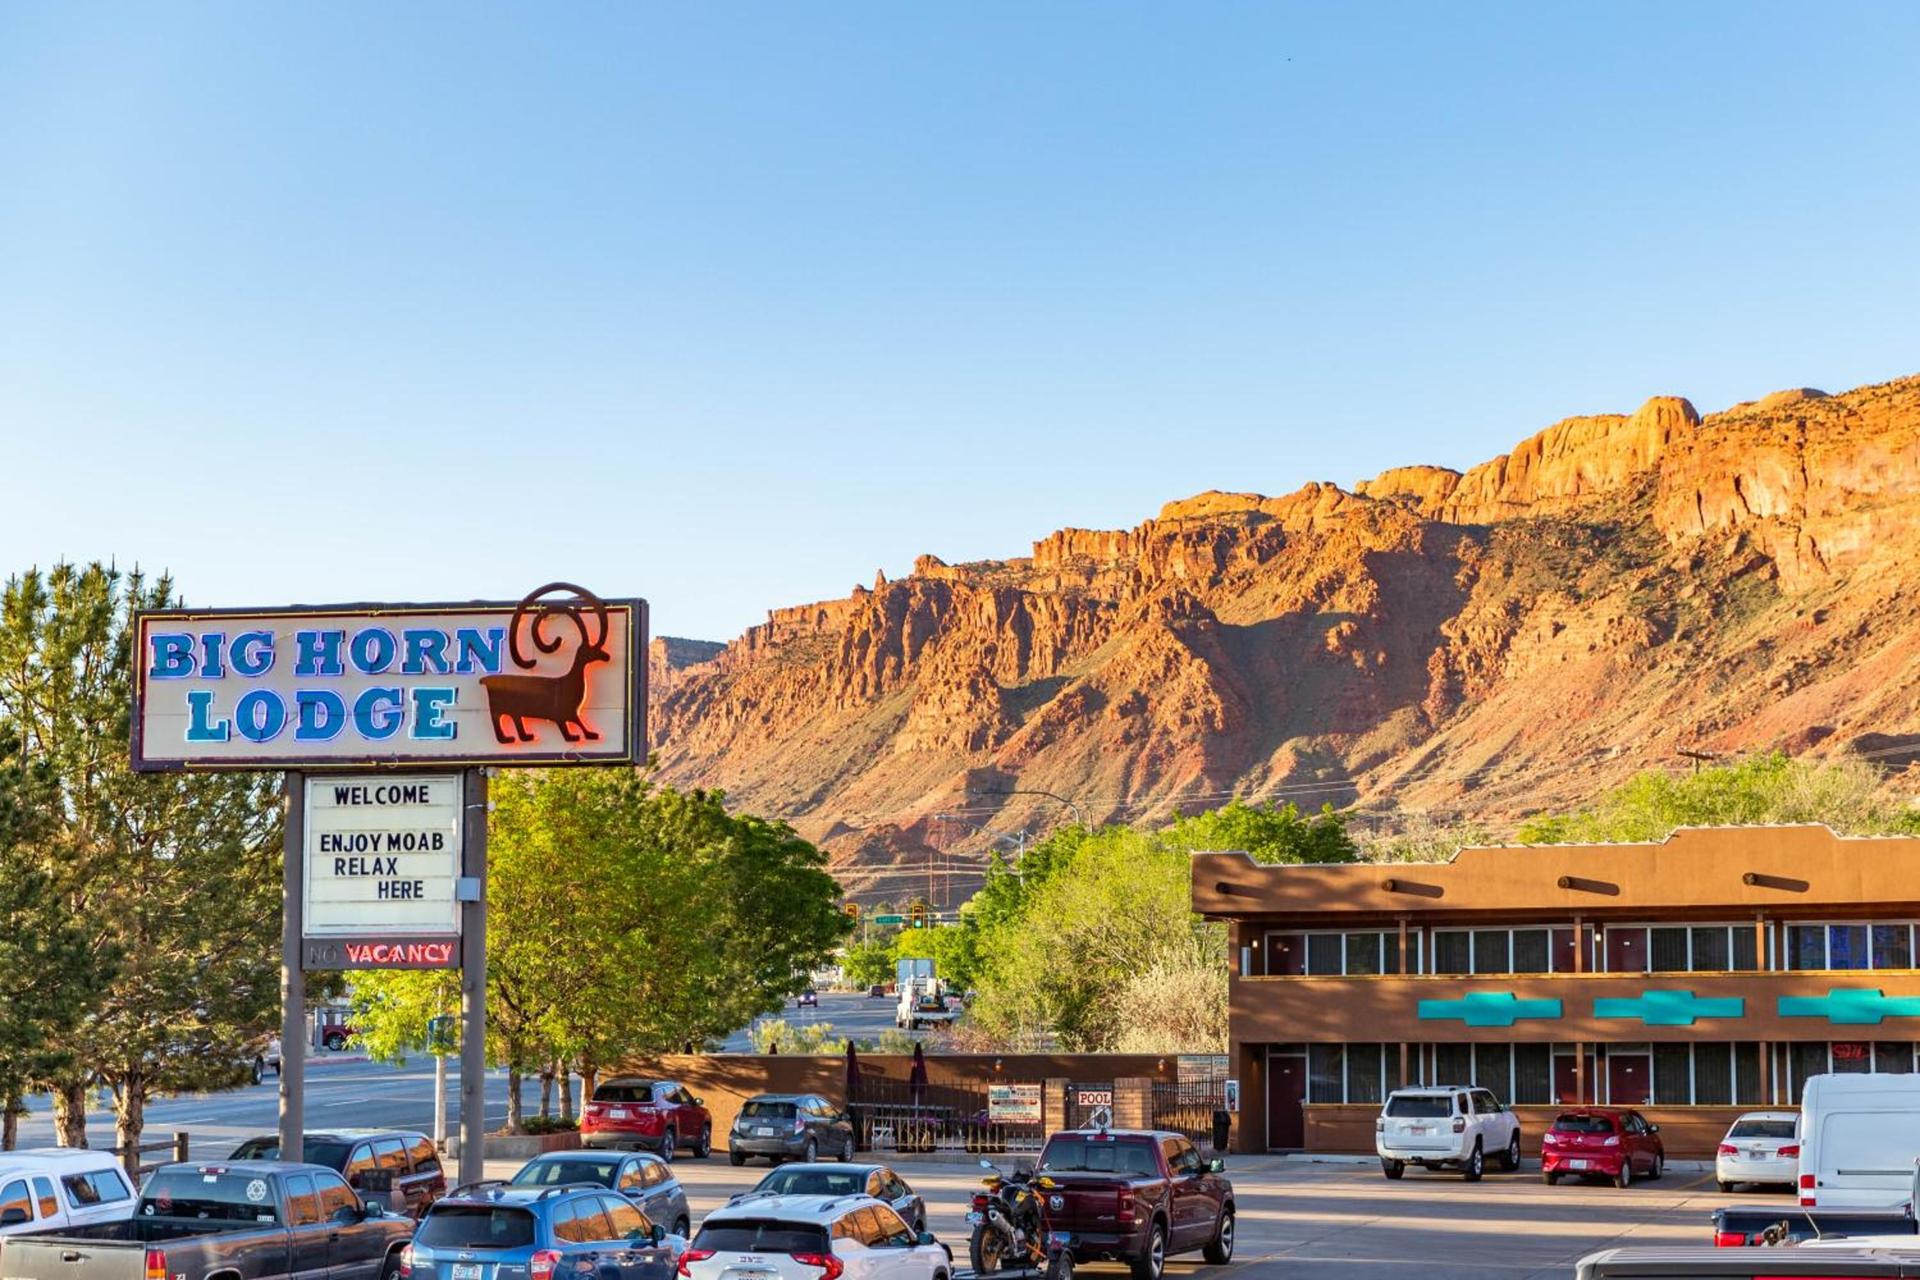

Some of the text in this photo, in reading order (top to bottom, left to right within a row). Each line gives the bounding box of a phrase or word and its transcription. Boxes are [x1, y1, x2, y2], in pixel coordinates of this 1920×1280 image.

[150, 627, 505, 678] BIG HORN
[186, 687, 458, 742] LODGE
[335, 785, 429, 805] WELCOME
[320, 833, 443, 852] ENJOY MOAB
[334, 857, 398, 876] RELAX
[378, 881, 423, 899] HERE
[309, 943, 454, 964] NO VACANCY
[1080, 1093, 1110, 1104] POOL
